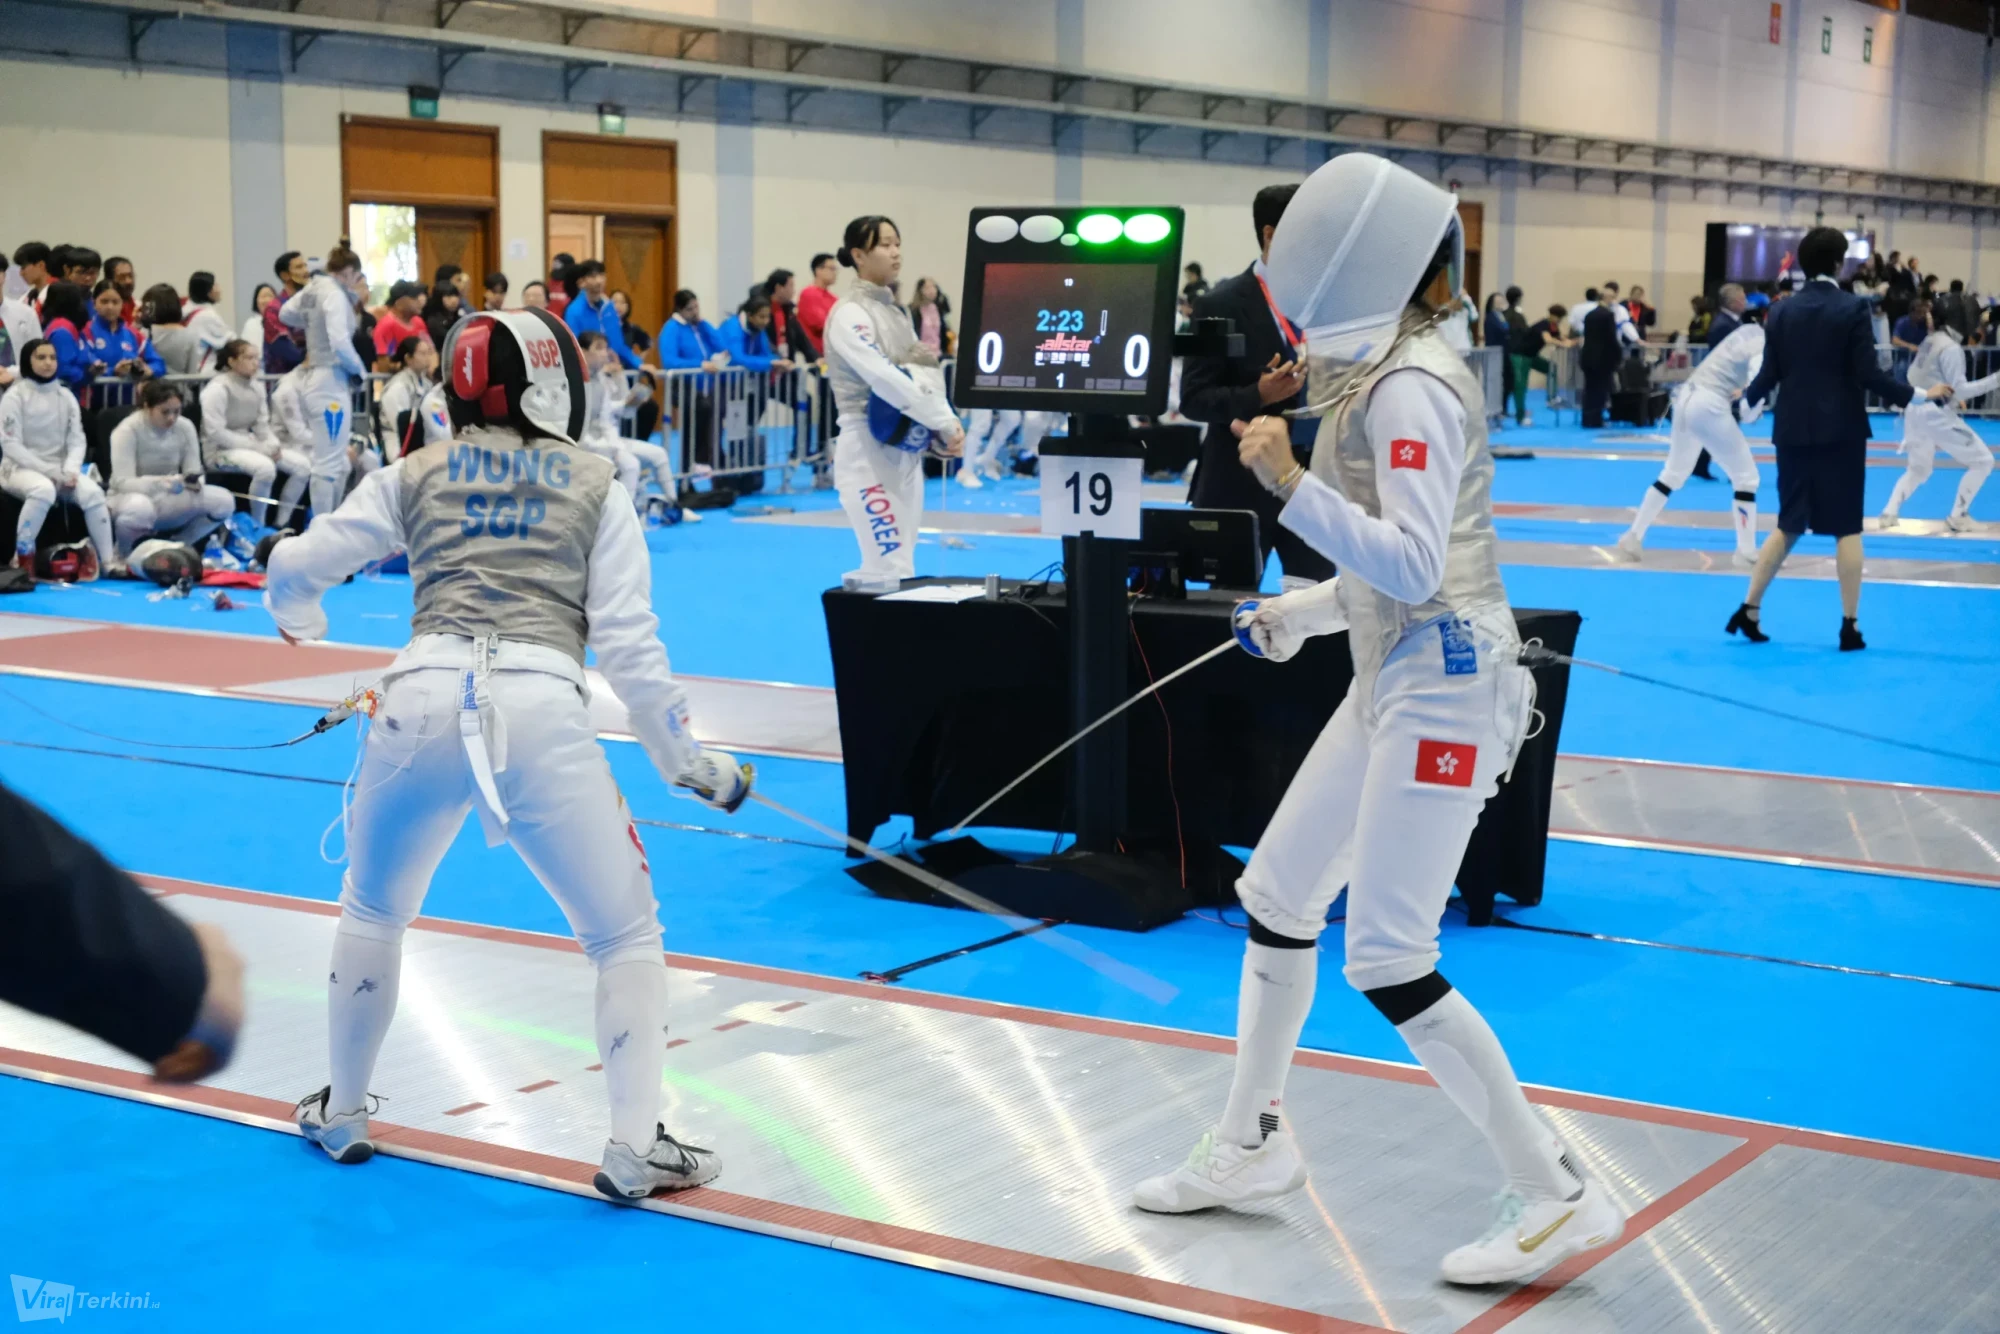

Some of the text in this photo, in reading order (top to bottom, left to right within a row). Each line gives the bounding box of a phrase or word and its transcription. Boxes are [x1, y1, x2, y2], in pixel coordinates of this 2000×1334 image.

[1036, 309, 1084, 332] 2:23
[1043, 332, 1093, 352] allstar
[525, 338, 561, 369] SGP
[978, 331, 1003, 374] 0
[1124, 334, 1150, 378] 0
[1056, 372, 1065, 388] 1
[1064, 471, 1113, 517] 19
[461, 493, 546, 541] SGP
[860, 483, 902, 557] KOREA
